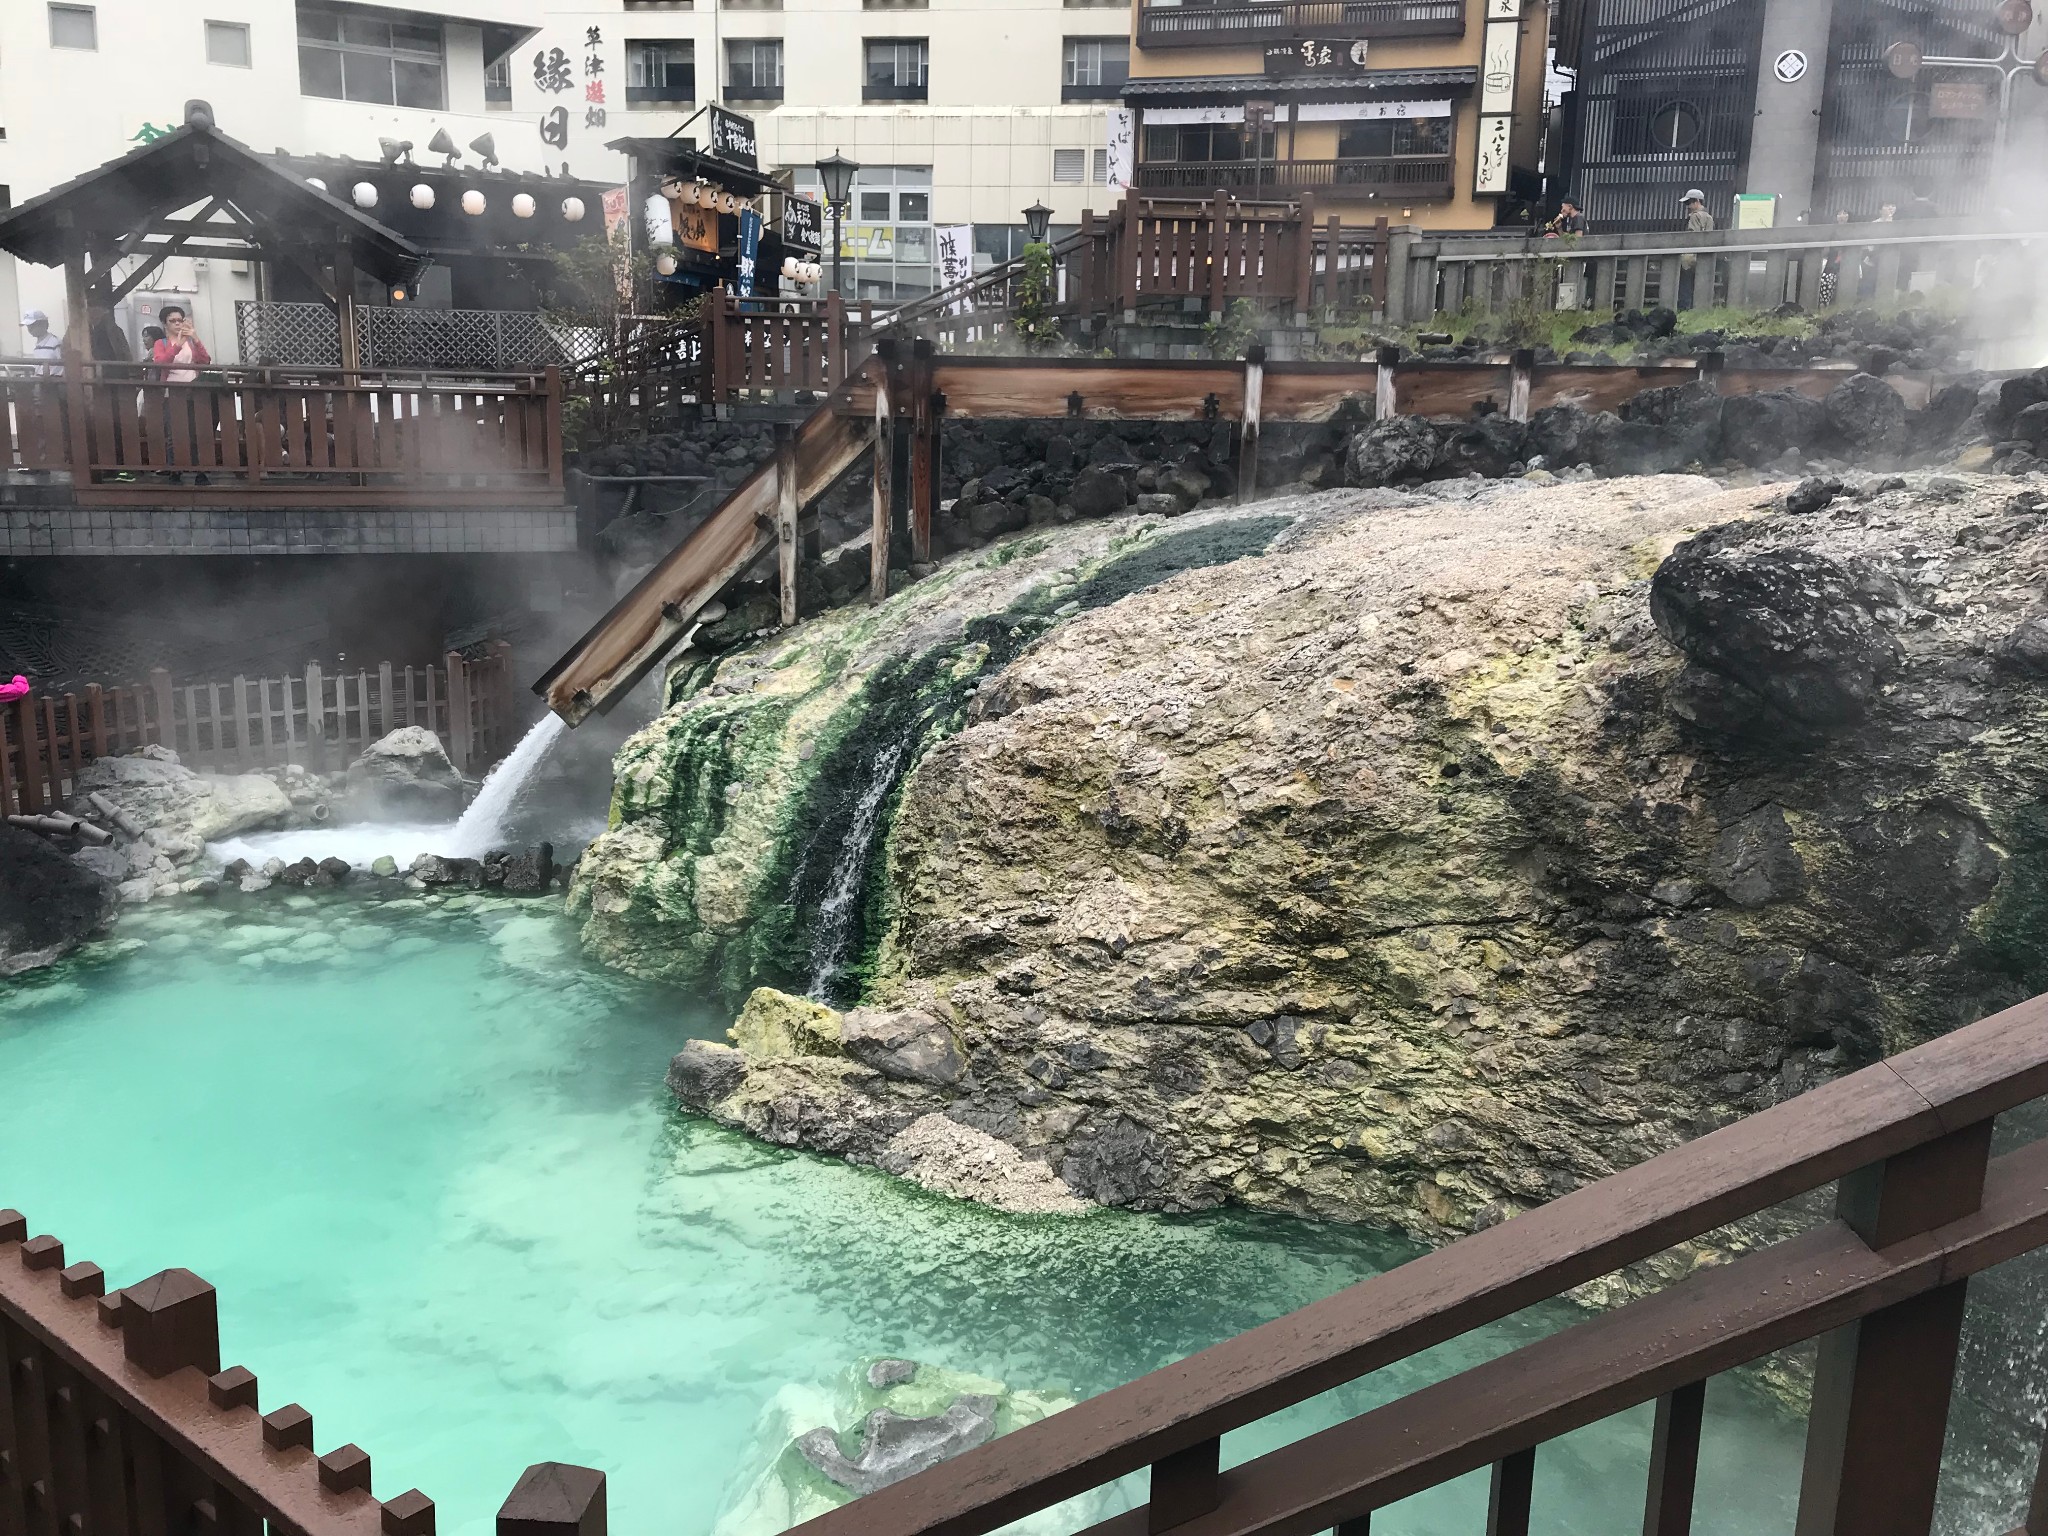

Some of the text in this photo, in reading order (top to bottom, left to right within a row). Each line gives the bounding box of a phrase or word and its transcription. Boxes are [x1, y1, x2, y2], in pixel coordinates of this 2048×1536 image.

[533, 46, 574, 178] 縁日
[1118, 113, 1131, 144] そば
[725, 130, 756, 156] 十割そば
[1109, 139, 1120, 185] うどん
